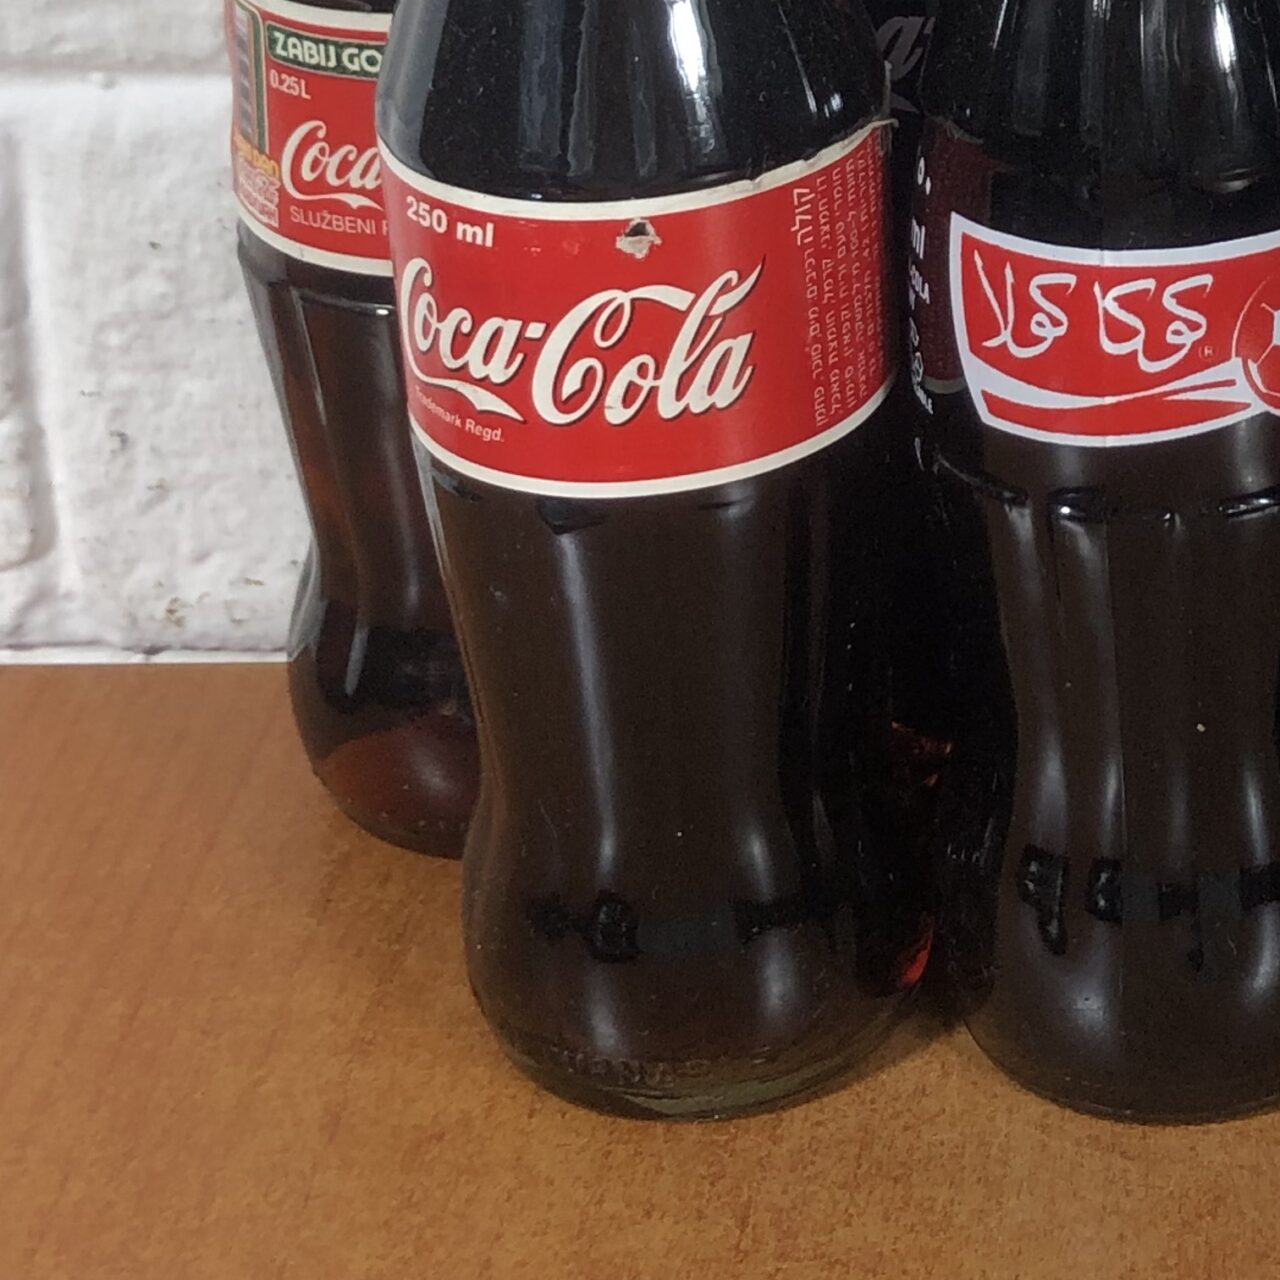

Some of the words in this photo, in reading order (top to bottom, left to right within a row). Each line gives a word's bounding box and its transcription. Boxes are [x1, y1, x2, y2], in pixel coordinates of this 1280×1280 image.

[273, 31, 337, 70] ZABIJ
[281, 119, 385, 212] Coca
[832, 167, 843, 215] חומרי
[290, 205, 377, 237] SLUŽBENI
[406, 195, 449, 236] 250
[456, 214, 494, 248] ml
[835, 222, 846, 258] טעם
[791, 188, 815, 245] קולה
[814, 386, 828, 426] פחמן
[400, 255, 766, 426] Coca-Cola
[826, 311, 838, 364] חומצת
